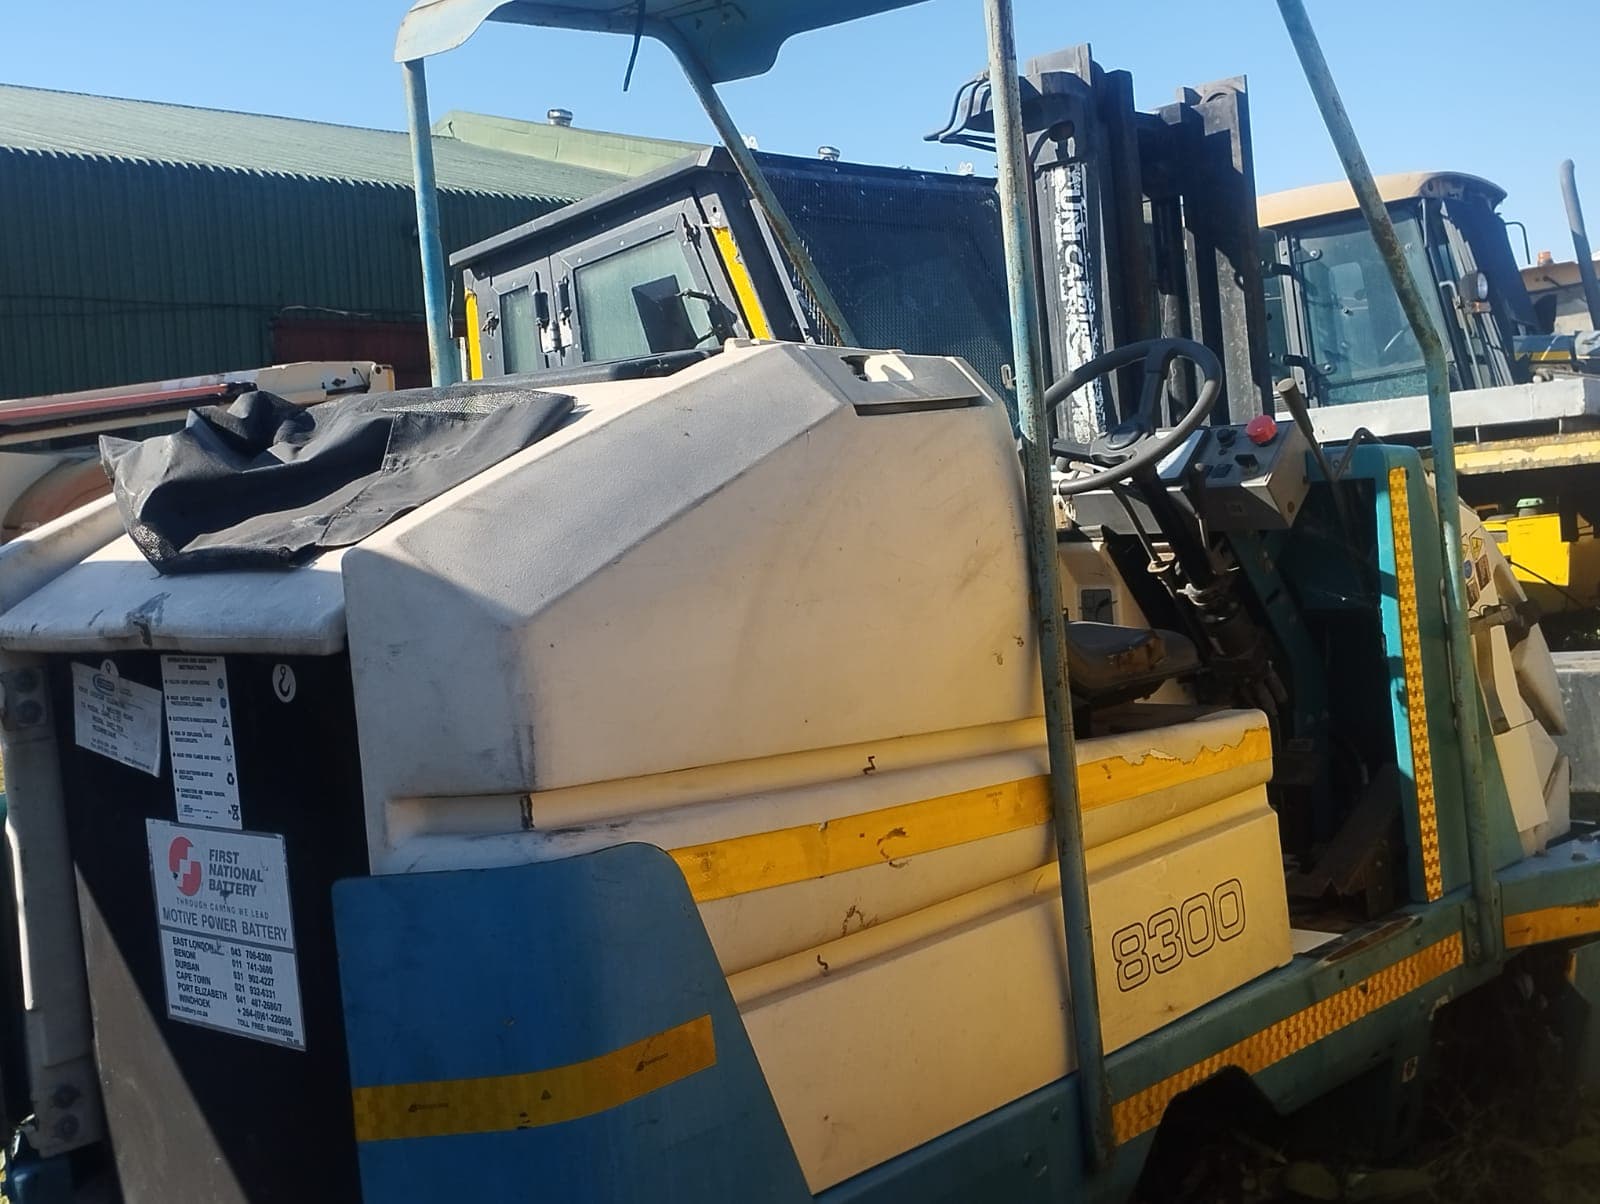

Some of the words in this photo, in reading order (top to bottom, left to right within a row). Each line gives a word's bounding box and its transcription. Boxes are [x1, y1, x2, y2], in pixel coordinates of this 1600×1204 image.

[209, 849, 240, 865] FIRST
[209, 863, 264, 883] NATIONAL
[209, 879, 257, 898] BATTERY
[176, 897, 208, 910] THROUGH
[210, 904, 236, 914] CARING
[239, 908, 248, 917] WE
[251, 910, 270, 920] LEAD
[162, 907, 198, 926] MOTIVE
[202, 913, 238, 933] POWER
[242, 921, 288, 941] BATTERY
[173, 936, 188, 947] EAST
[1111, 878, 1246, 993] 8300
[174, 959, 200, 972] DURBAN
[176, 970, 193, 982] CAPE
[193, 975, 212, 986] TOWN
[177, 982, 194, 993] PORT
[194, 985, 228, 1000] ELIZABETH
